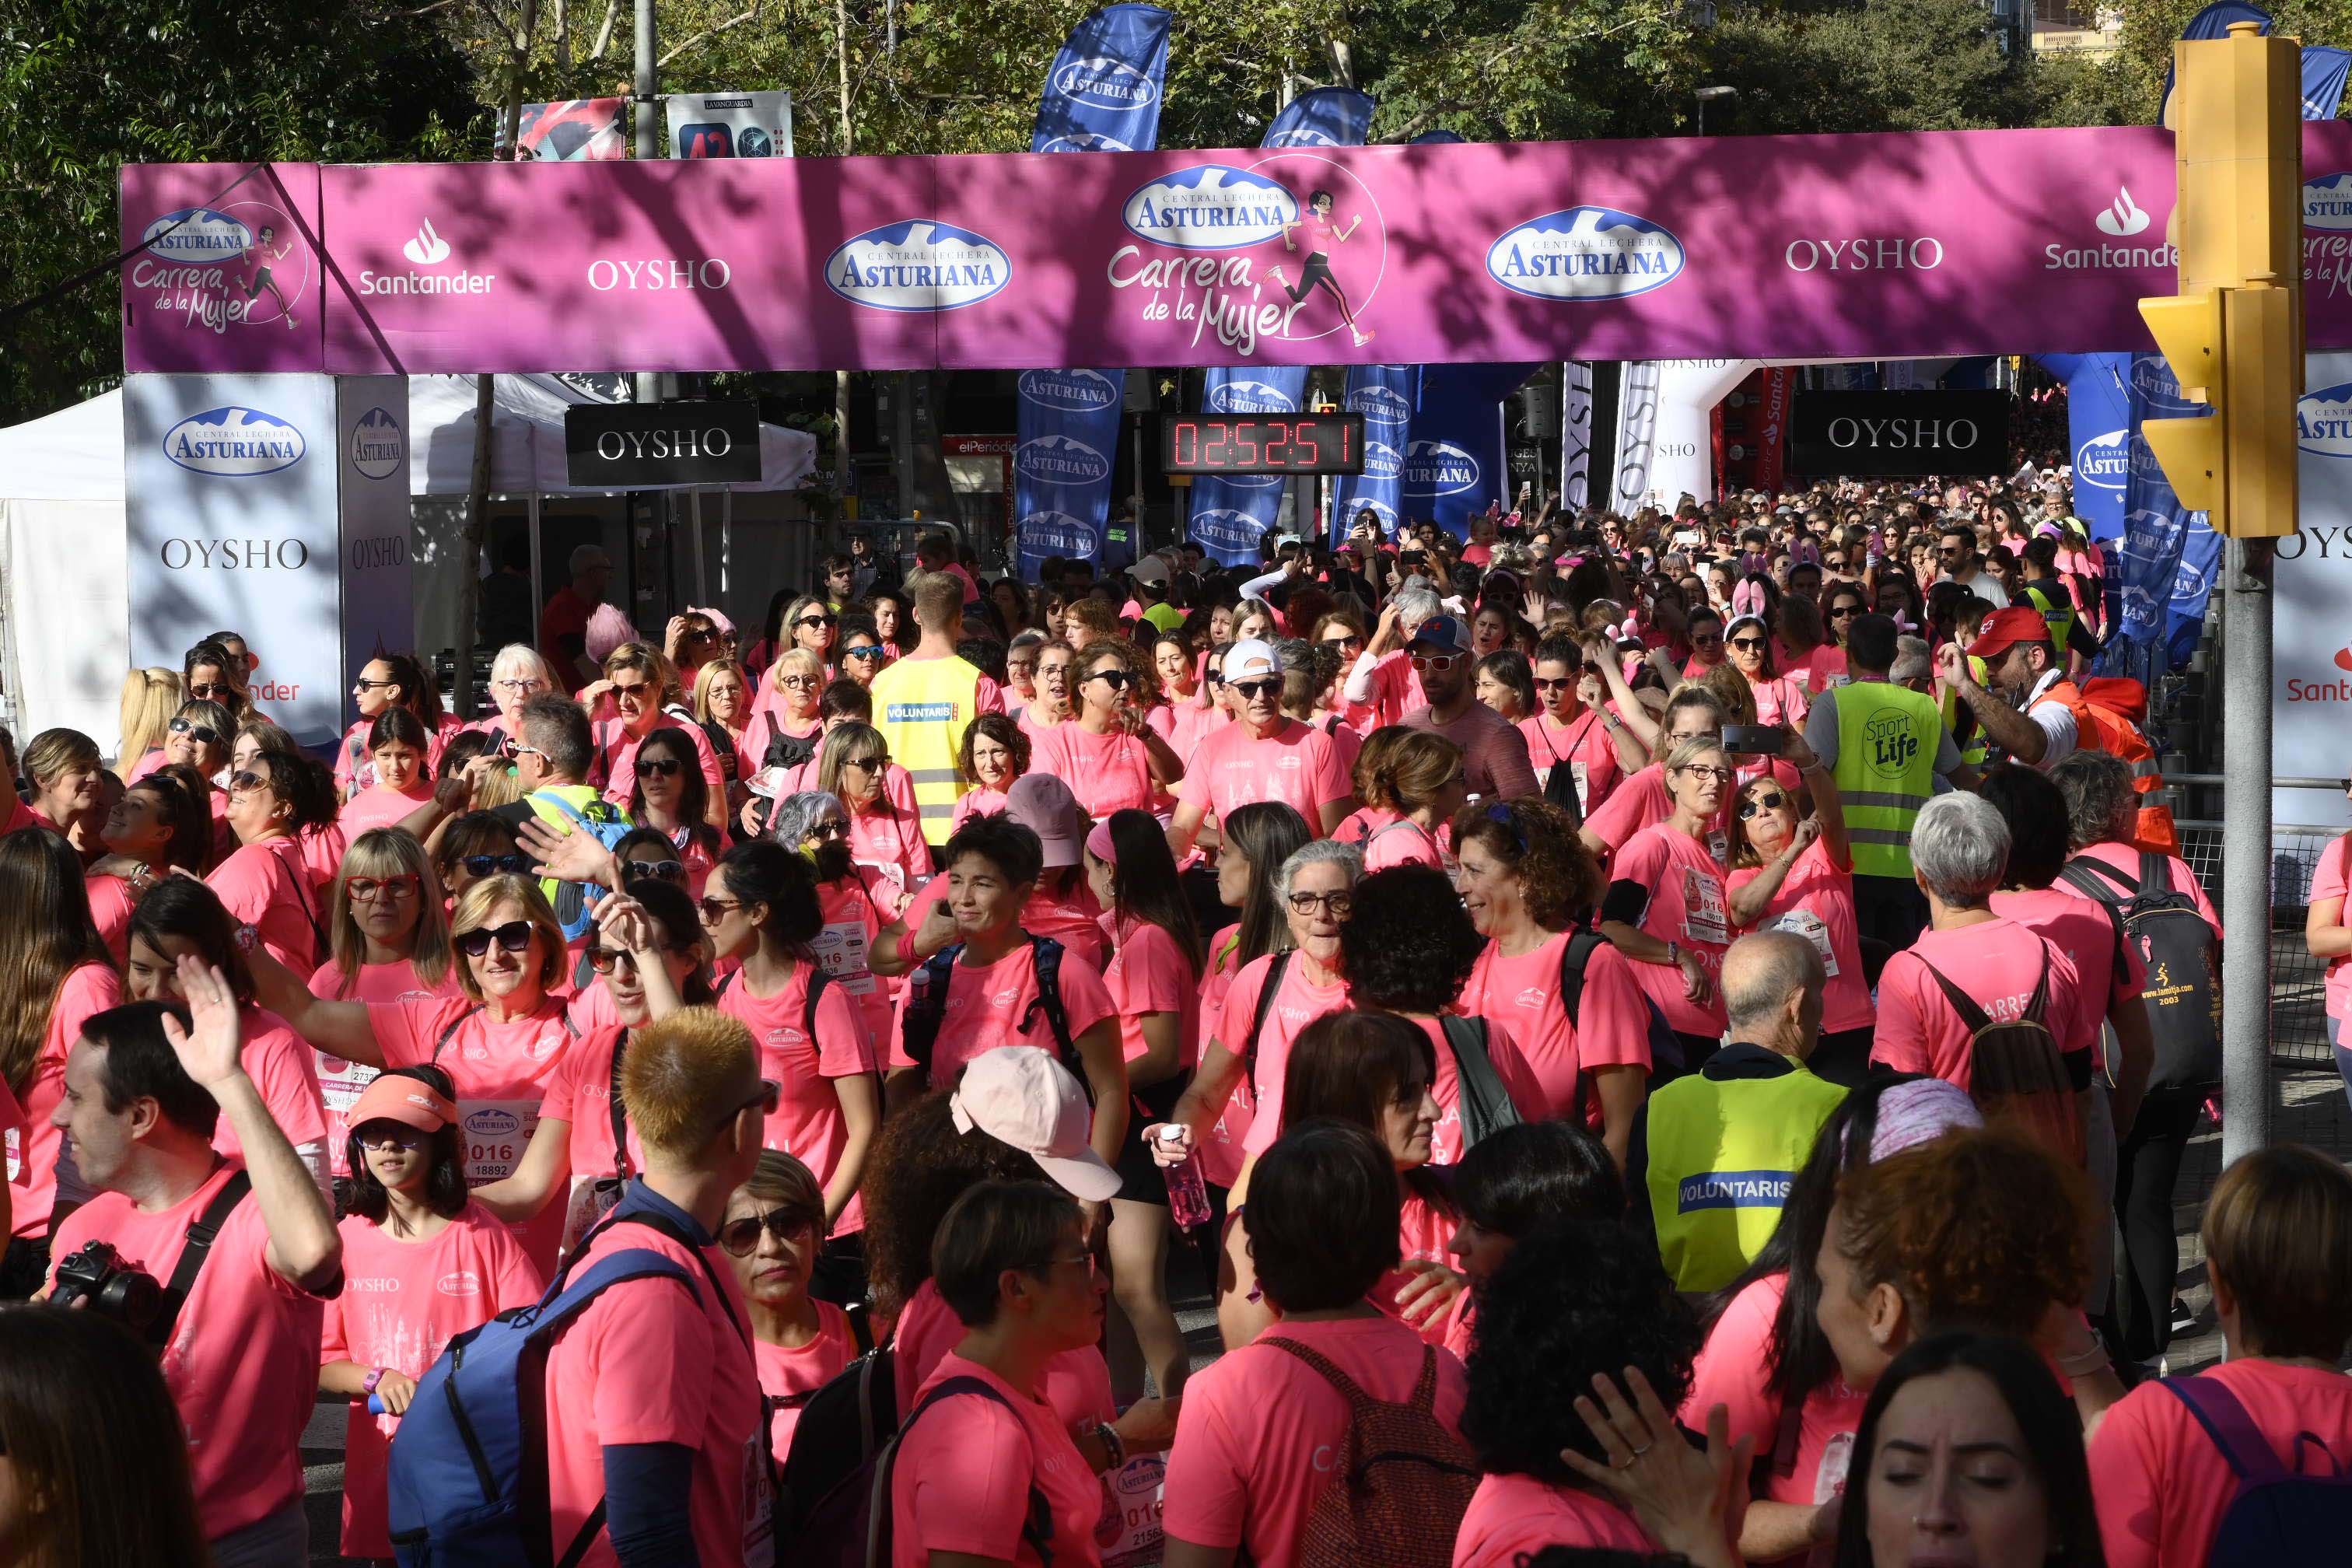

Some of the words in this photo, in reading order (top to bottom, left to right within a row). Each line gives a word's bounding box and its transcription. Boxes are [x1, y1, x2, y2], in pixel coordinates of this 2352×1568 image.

[1061, 70, 1147, 102] ASTURIANA
[1224, 194, 1280, 202] LECHERA
[1136, 197, 1284, 229] ASTURIANA
[151, 229, 243, 249] ASTURIANA
[1532, 239, 1594, 249] CENTRAL
[1600, 237, 1663, 248] LECHERA
[867, 250, 927, 261] CENTRAL
[1107, 245, 1253, 289] Carrera
[1502, 249, 1668, 278] ASTURIANA
[1786, 237, 1944, 271] OYSHO
[2046, 243, 2179, 269] Santande
[132, 259, 223, 289] Carrera
[360, 270, 495, 295] Santander
[587, 258, 731, 291] OYSHO
[838, 254, 996, 289] ASTURIANA
[156, 290, 171, 310] de
[176, 289, 187, 310] la
[186, 285, 258, 334] Mujer
[1143, 291, 1169, 320] de
[1176, 289, 1195, 320] la
[1191, 284, 1307, 356] Mujer
[1025, 375, 1108, 404] ASTURIANA
[1351, 396, 1407, 419] ASTURIANA
[174, 432, 296, 459] ASTURIANA
[597, 428, 731, 460] OYSHO
[1175, 423, 1348, 465] 02:52:51
[1829, 417, 1978, 449] OYSHO
[355, 434, 400, 462] ASTURIANA
[1020, 450, 1101, 477] ASTURIANA
[161, 538, 309, 570] OYSHO
[352, 535, 404, 570] OYSHO
[888, 707, 950, 718] VOLUNTARIS
[1867, 715, 1910, 741] Sport
[1875, 733, 1918, 766] Life
[1704, 898, 1724, 913] 016
[824, 953, 842, 964] 16
[2141, 984, 2193, 999] www.lamitja.com
[2159, 996, 2179, 1006] 2003
[325, 1082, 353, 1090] CARRERA
[469, 1118, 516, 1129] ASTURIANA
[471, 1144, 513, 1160] 016
[475, 1165, 508, 1176] 18892
[1680, 1181, 1792, 1203] VOLUNTARIS
[345, 1278, 400, 1293] OYSHO
[1128, 1500, 1164, 1528] 016
